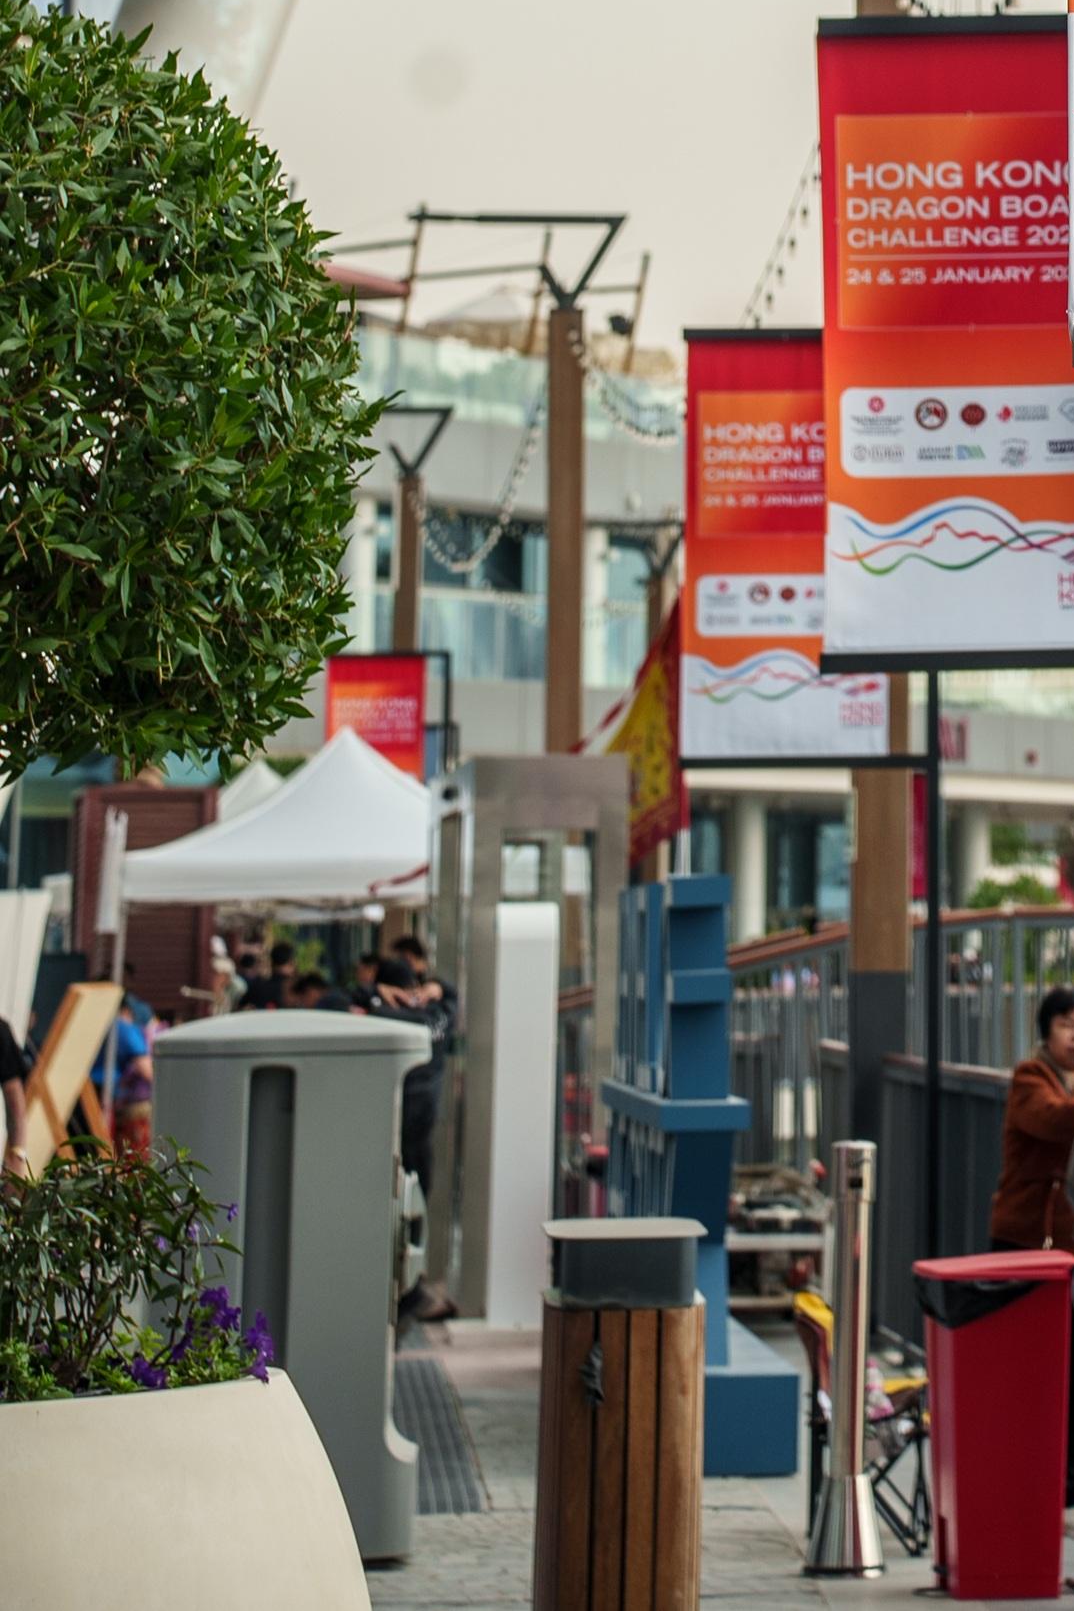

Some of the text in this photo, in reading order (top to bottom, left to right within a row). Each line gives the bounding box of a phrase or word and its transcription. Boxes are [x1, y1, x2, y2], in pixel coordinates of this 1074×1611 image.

[846, 159, 1069, 190] HONG KON
[847, 194, 1069, 220] DRAGON BOA
[847, 224, 1069, 249] CHALLENGE 202
[846, 267, 872, 285] 24
[899, 267, 927, 285] 25
[931, 265, 1035, 284] JANUARY
[1040, 265, 1069, 282] 20
[703, 422, 824, 444] HONG KO
